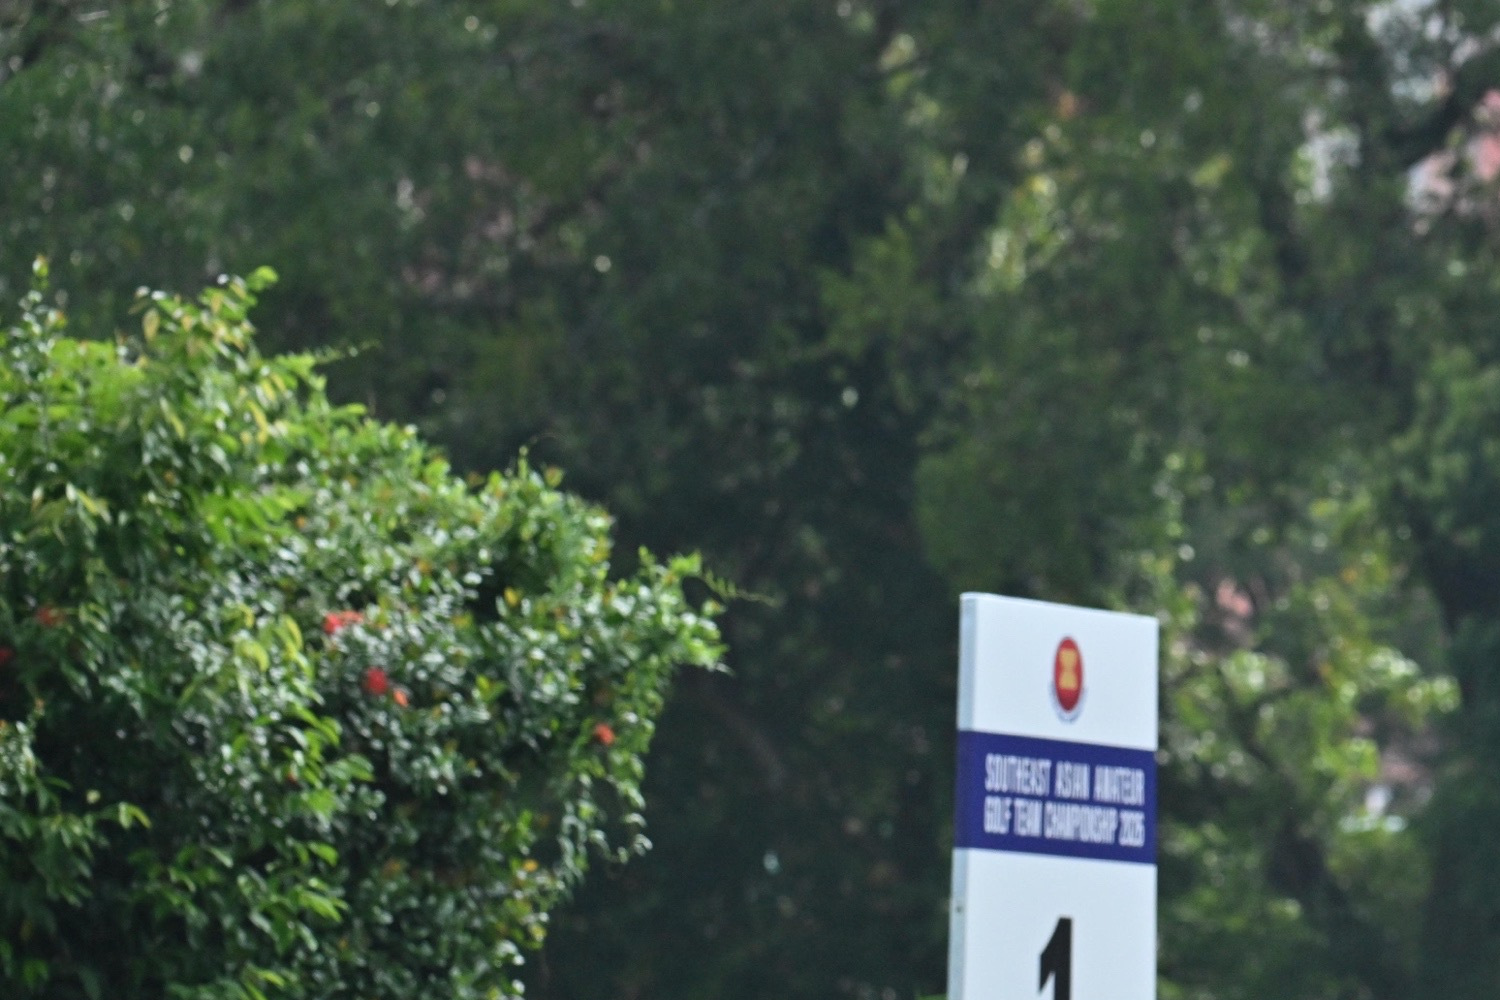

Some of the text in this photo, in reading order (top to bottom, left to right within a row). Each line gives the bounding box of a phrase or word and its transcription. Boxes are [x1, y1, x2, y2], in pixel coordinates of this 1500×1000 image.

[985, 753, 1145, 806] SOUTHEAST ASIAN AMATEUR
[984, 795, 1012, 835] GOLF
[1014, 797, 1043, 838] TEAM
[1044, 801, 1119, 844] CHAMPIONSHIP
